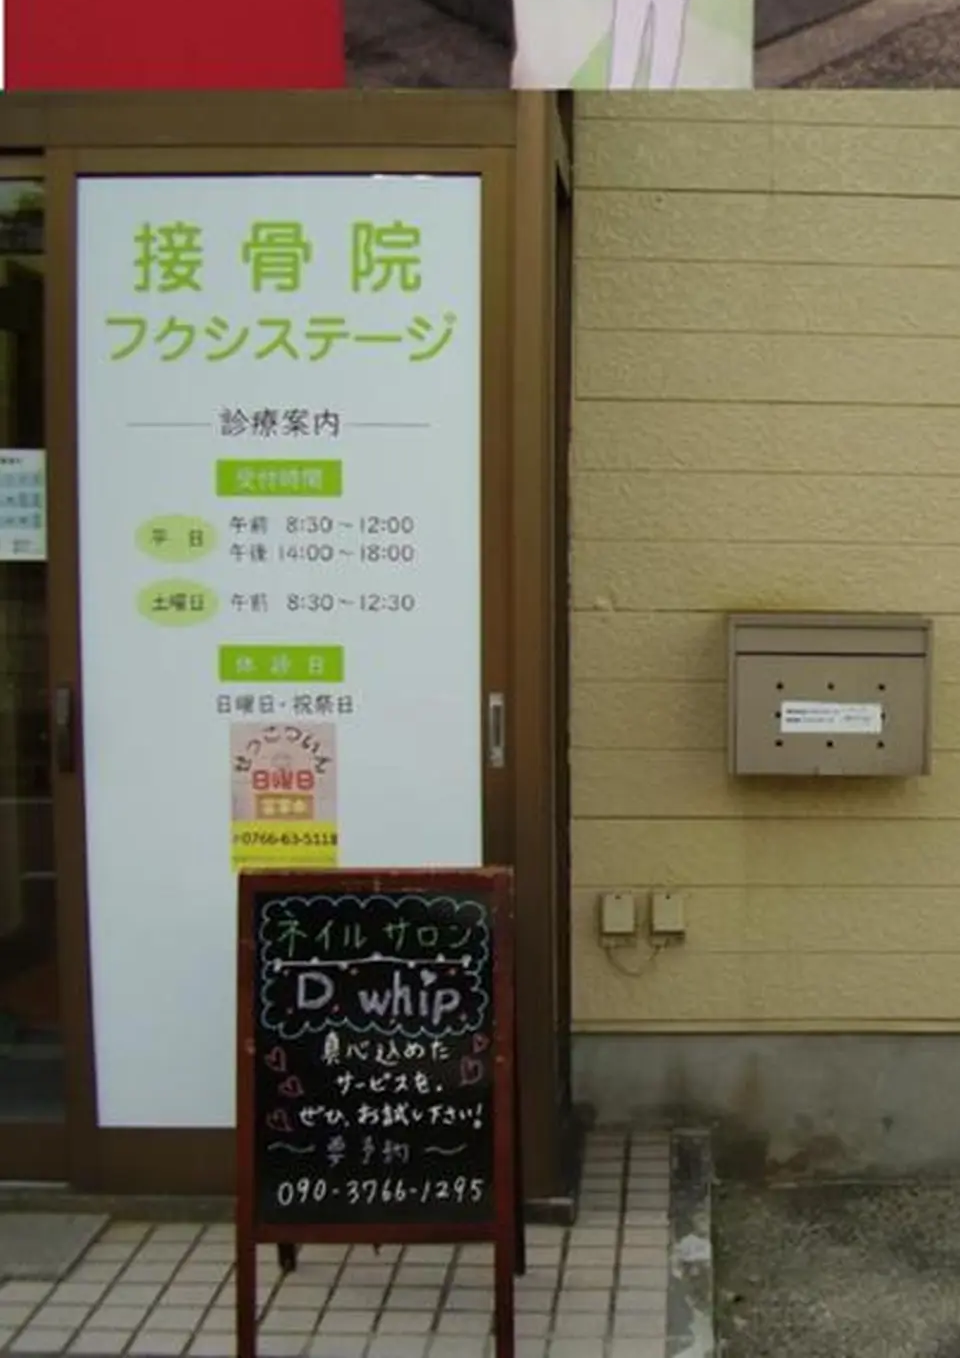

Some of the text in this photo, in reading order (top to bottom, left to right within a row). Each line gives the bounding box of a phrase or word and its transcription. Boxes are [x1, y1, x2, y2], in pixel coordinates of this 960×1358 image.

[133, 220, 422, 293] 接骨院
[105, 312, 458, 363] フクシステージ
[217, 407, 342, 439] 診療案内
[229, 514, 269, 535] 午前
[151, 592, 205, 612] 土曜日
[252, 769, 316, 791] 日曜日
[358, 969, 463, 1026] whip
[276, 1176, 485, 1206] 090-3766-1295
